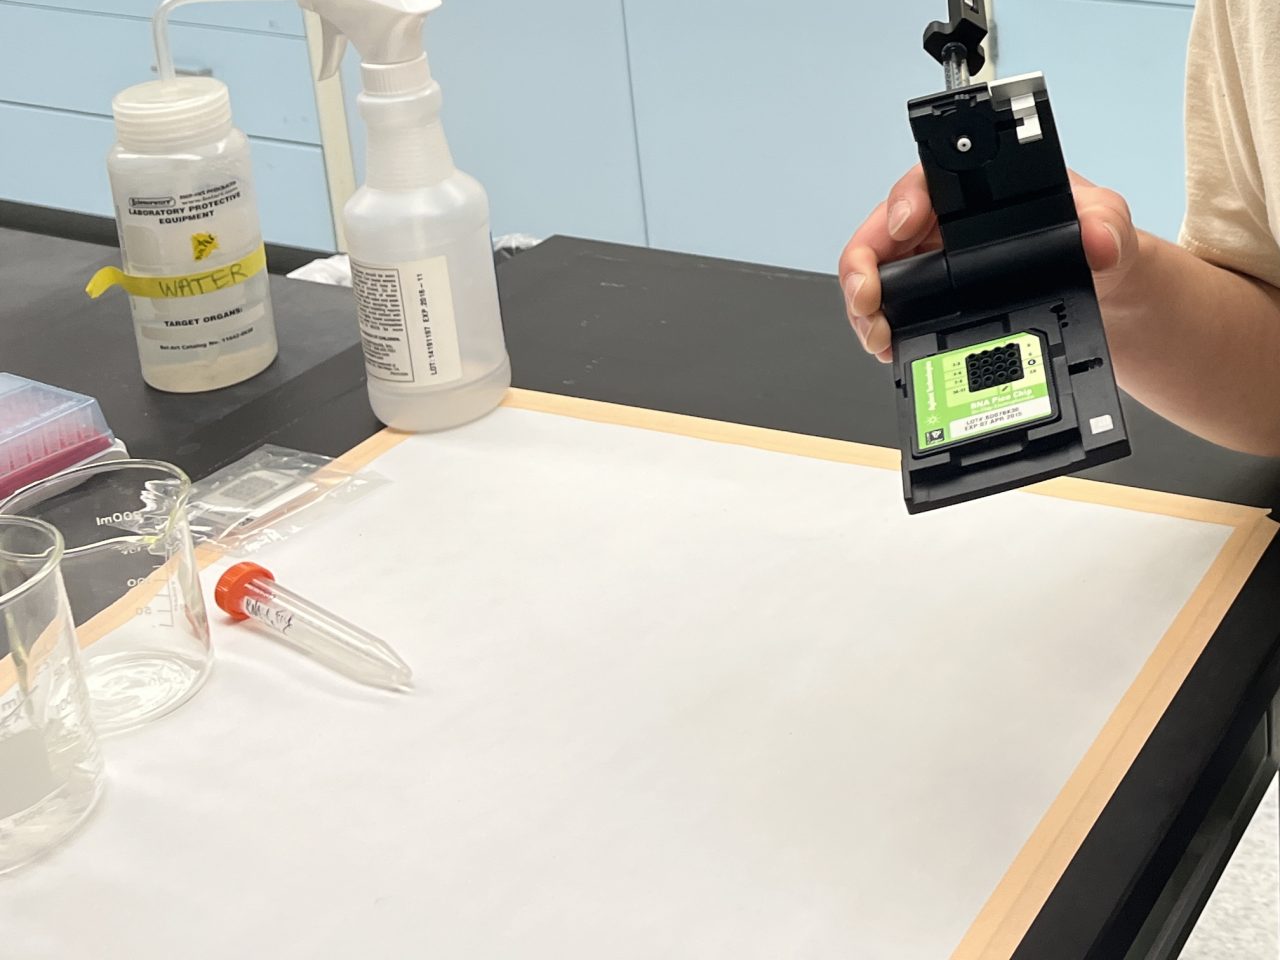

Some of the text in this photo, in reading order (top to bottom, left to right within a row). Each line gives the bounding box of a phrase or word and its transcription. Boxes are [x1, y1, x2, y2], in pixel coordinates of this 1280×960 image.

[128, 191, 240, 216] LABORATORY PROTECTIVE
[159, 210, 214, 224] EQUIPMENT
[158, 263, 248, 297] WATER
[164, 307, 243, 327] TARGET ORGANS:
[970, 400, 991, 410] RNA
[1013, 388, 1032, 401] Chip
